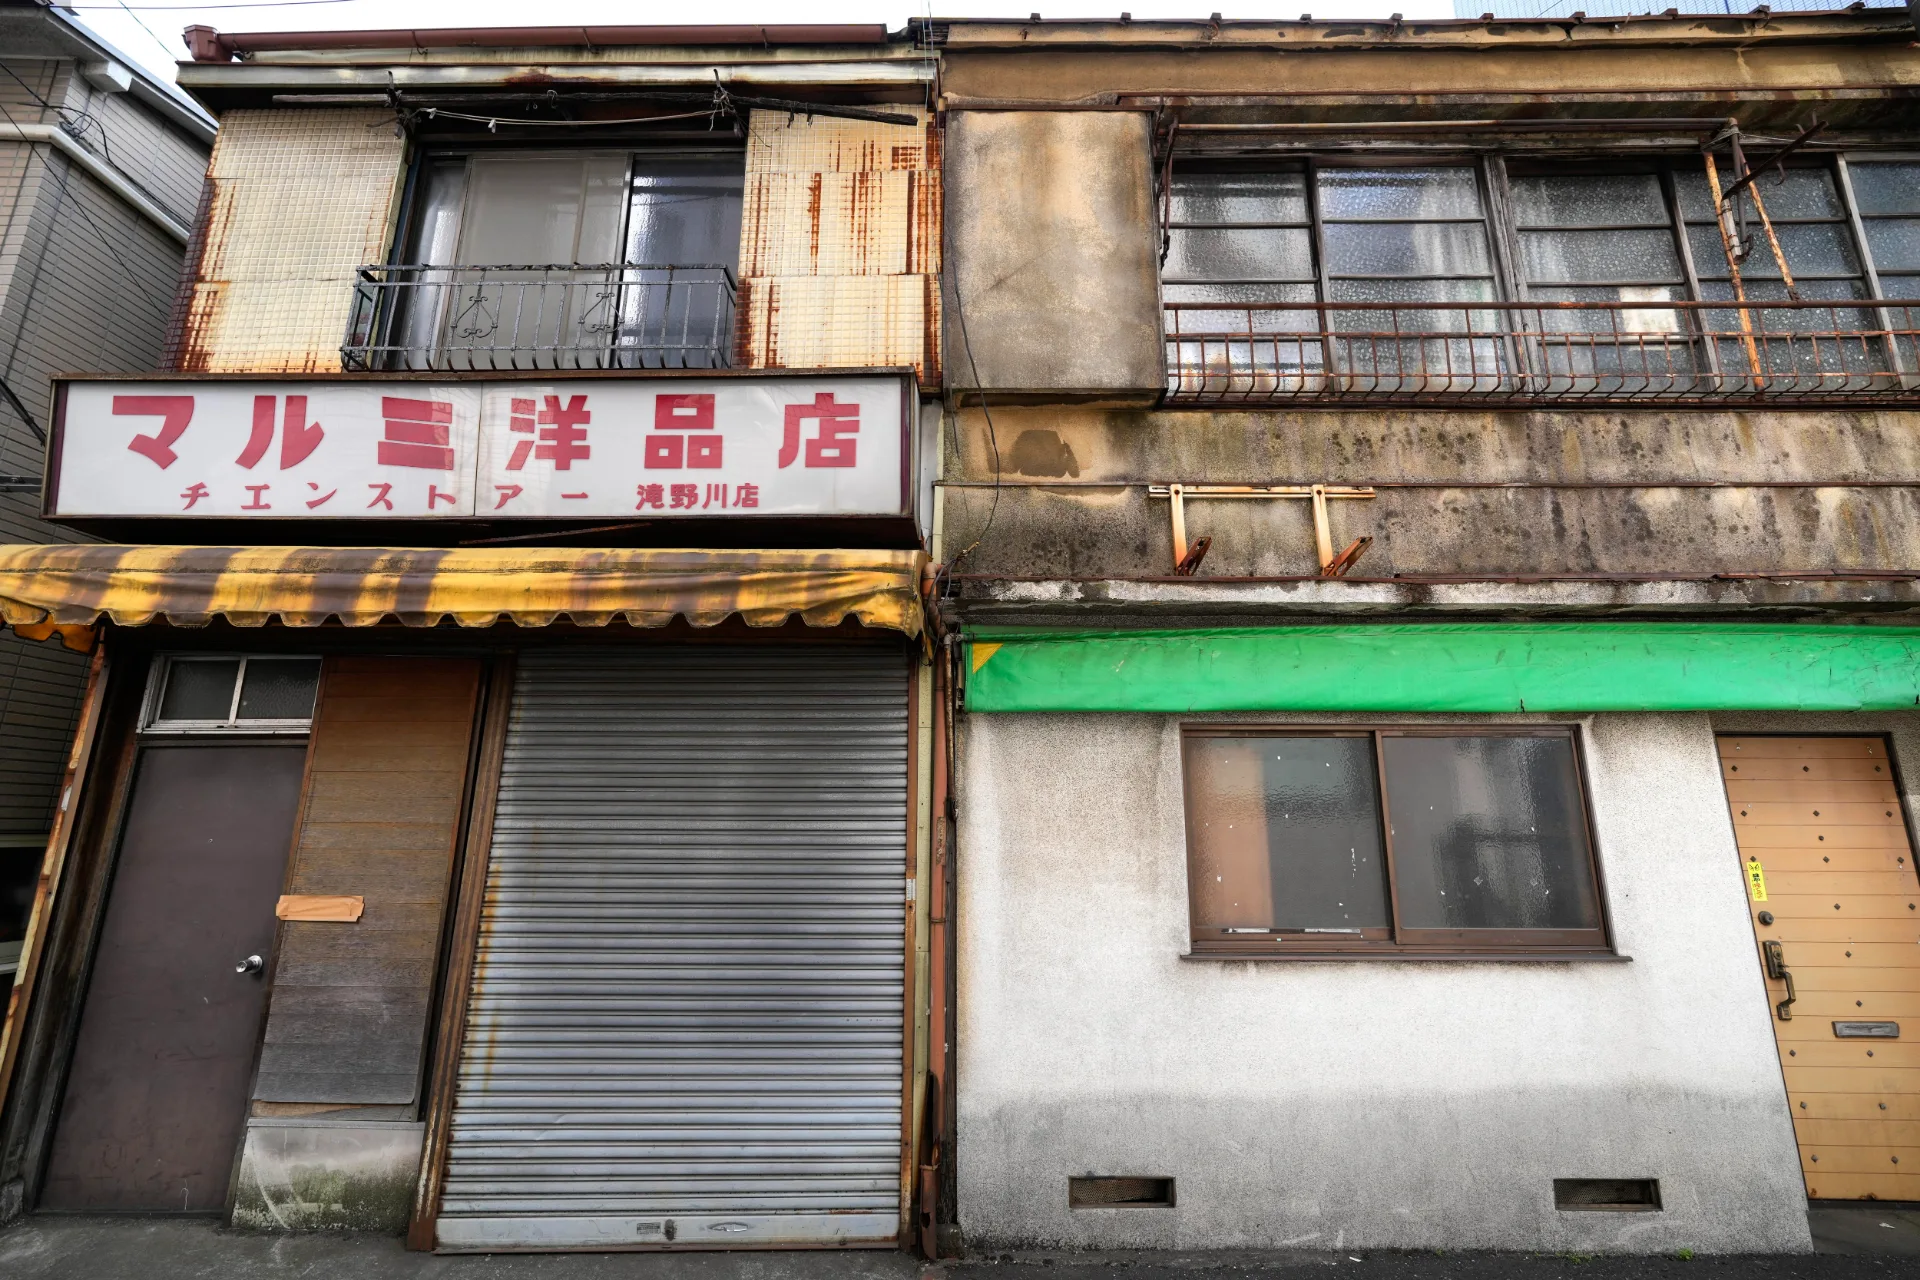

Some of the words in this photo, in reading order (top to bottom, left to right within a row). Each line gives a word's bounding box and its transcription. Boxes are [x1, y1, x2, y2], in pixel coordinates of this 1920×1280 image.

[112, 393, 861, 471] マルミ洋品店
[635, 483, 760, 511] 滝野川店
